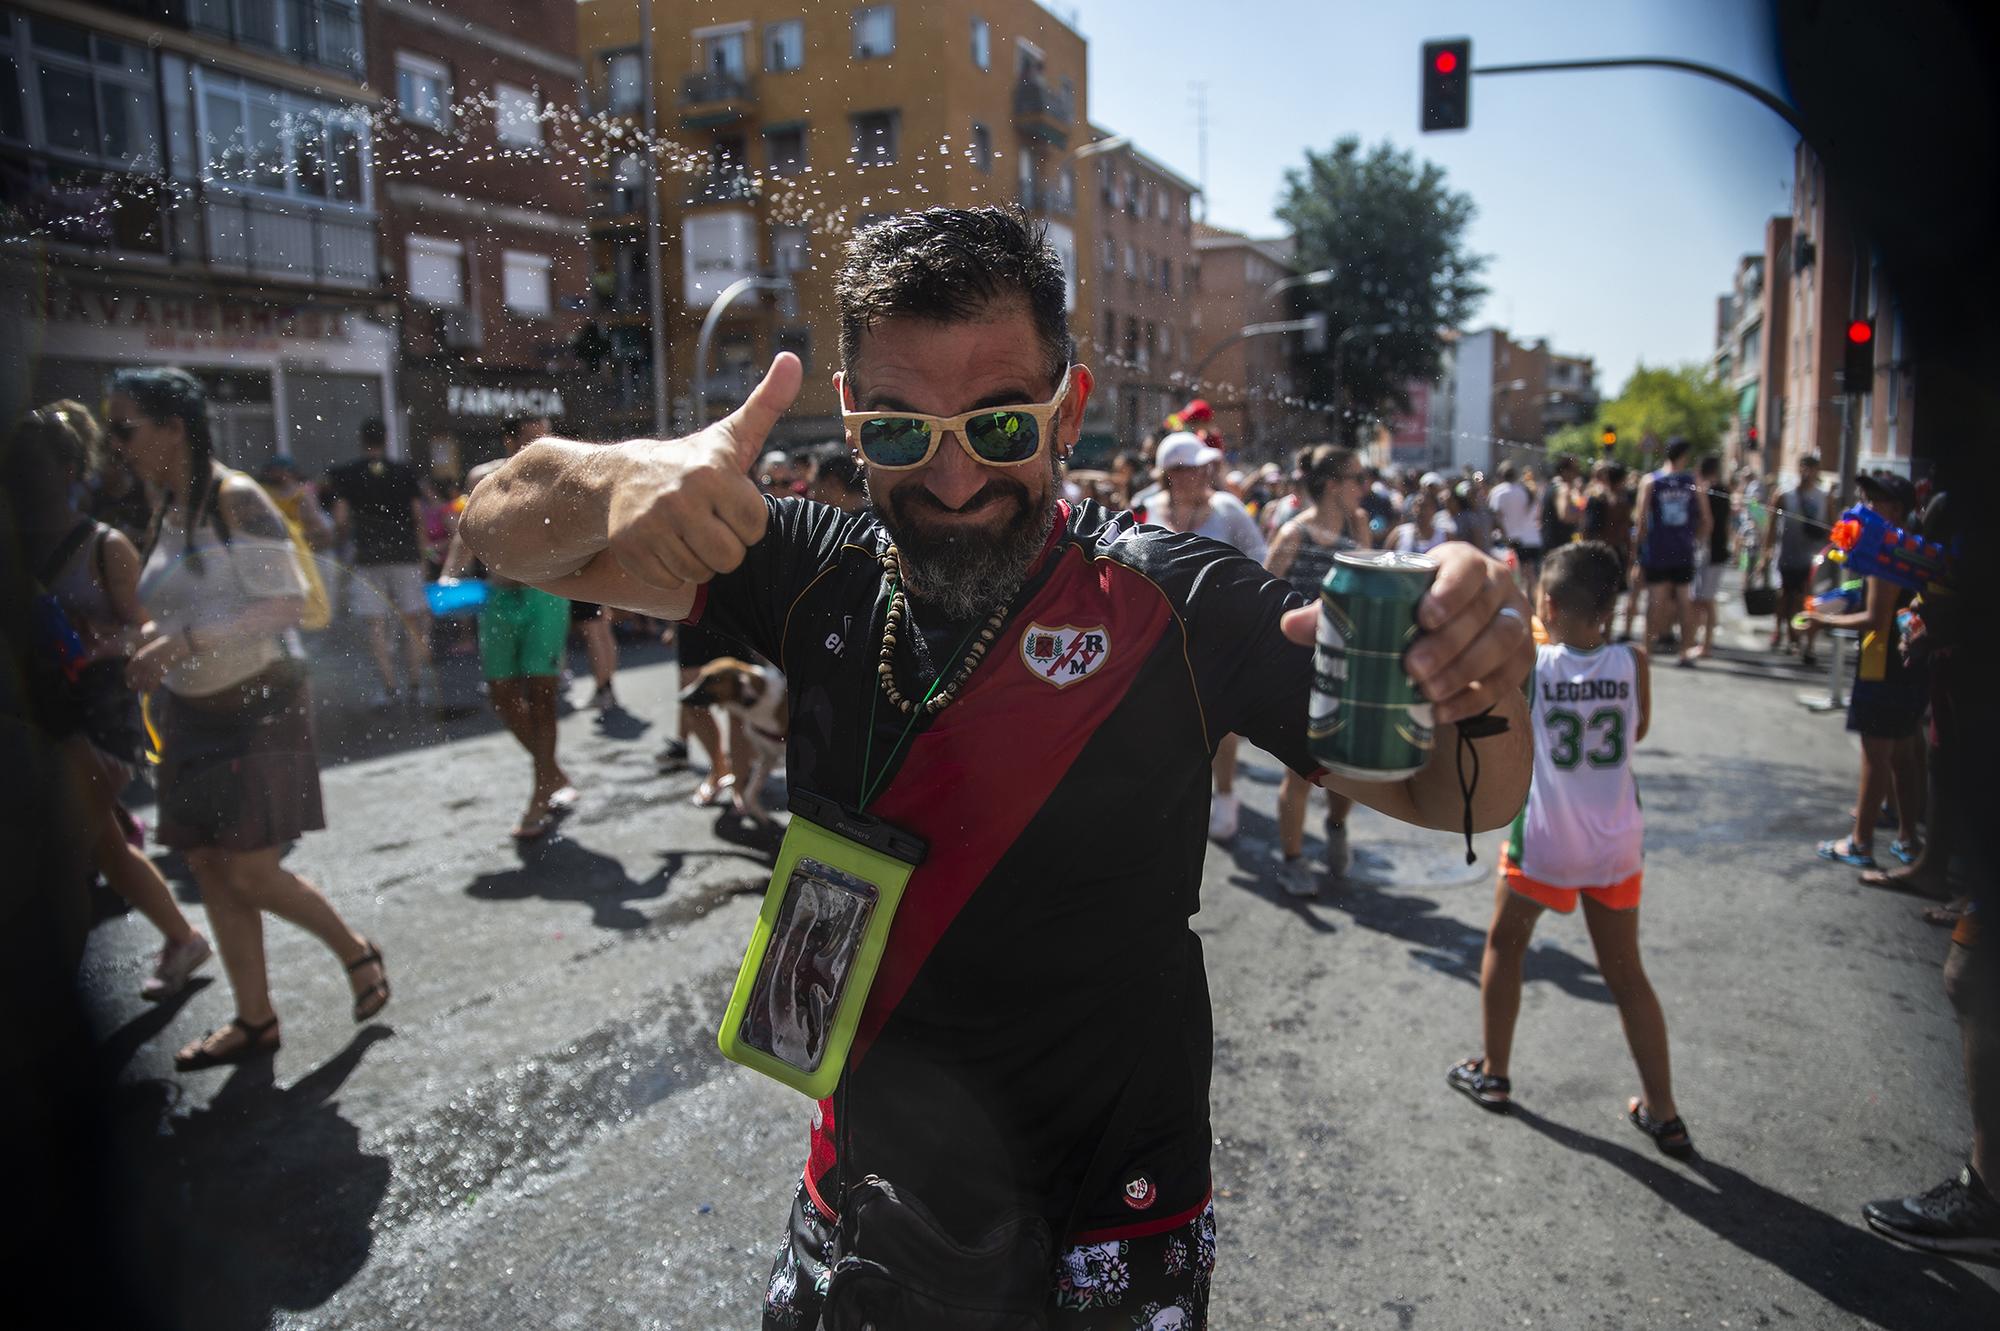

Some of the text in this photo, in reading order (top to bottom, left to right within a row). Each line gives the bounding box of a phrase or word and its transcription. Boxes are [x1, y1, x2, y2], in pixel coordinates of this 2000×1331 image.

[447, 386, 564, 416] FARMACIA
[1544, 681, 1629, 700] LEGENDS
[1545, 706, 1626, 771] 33
